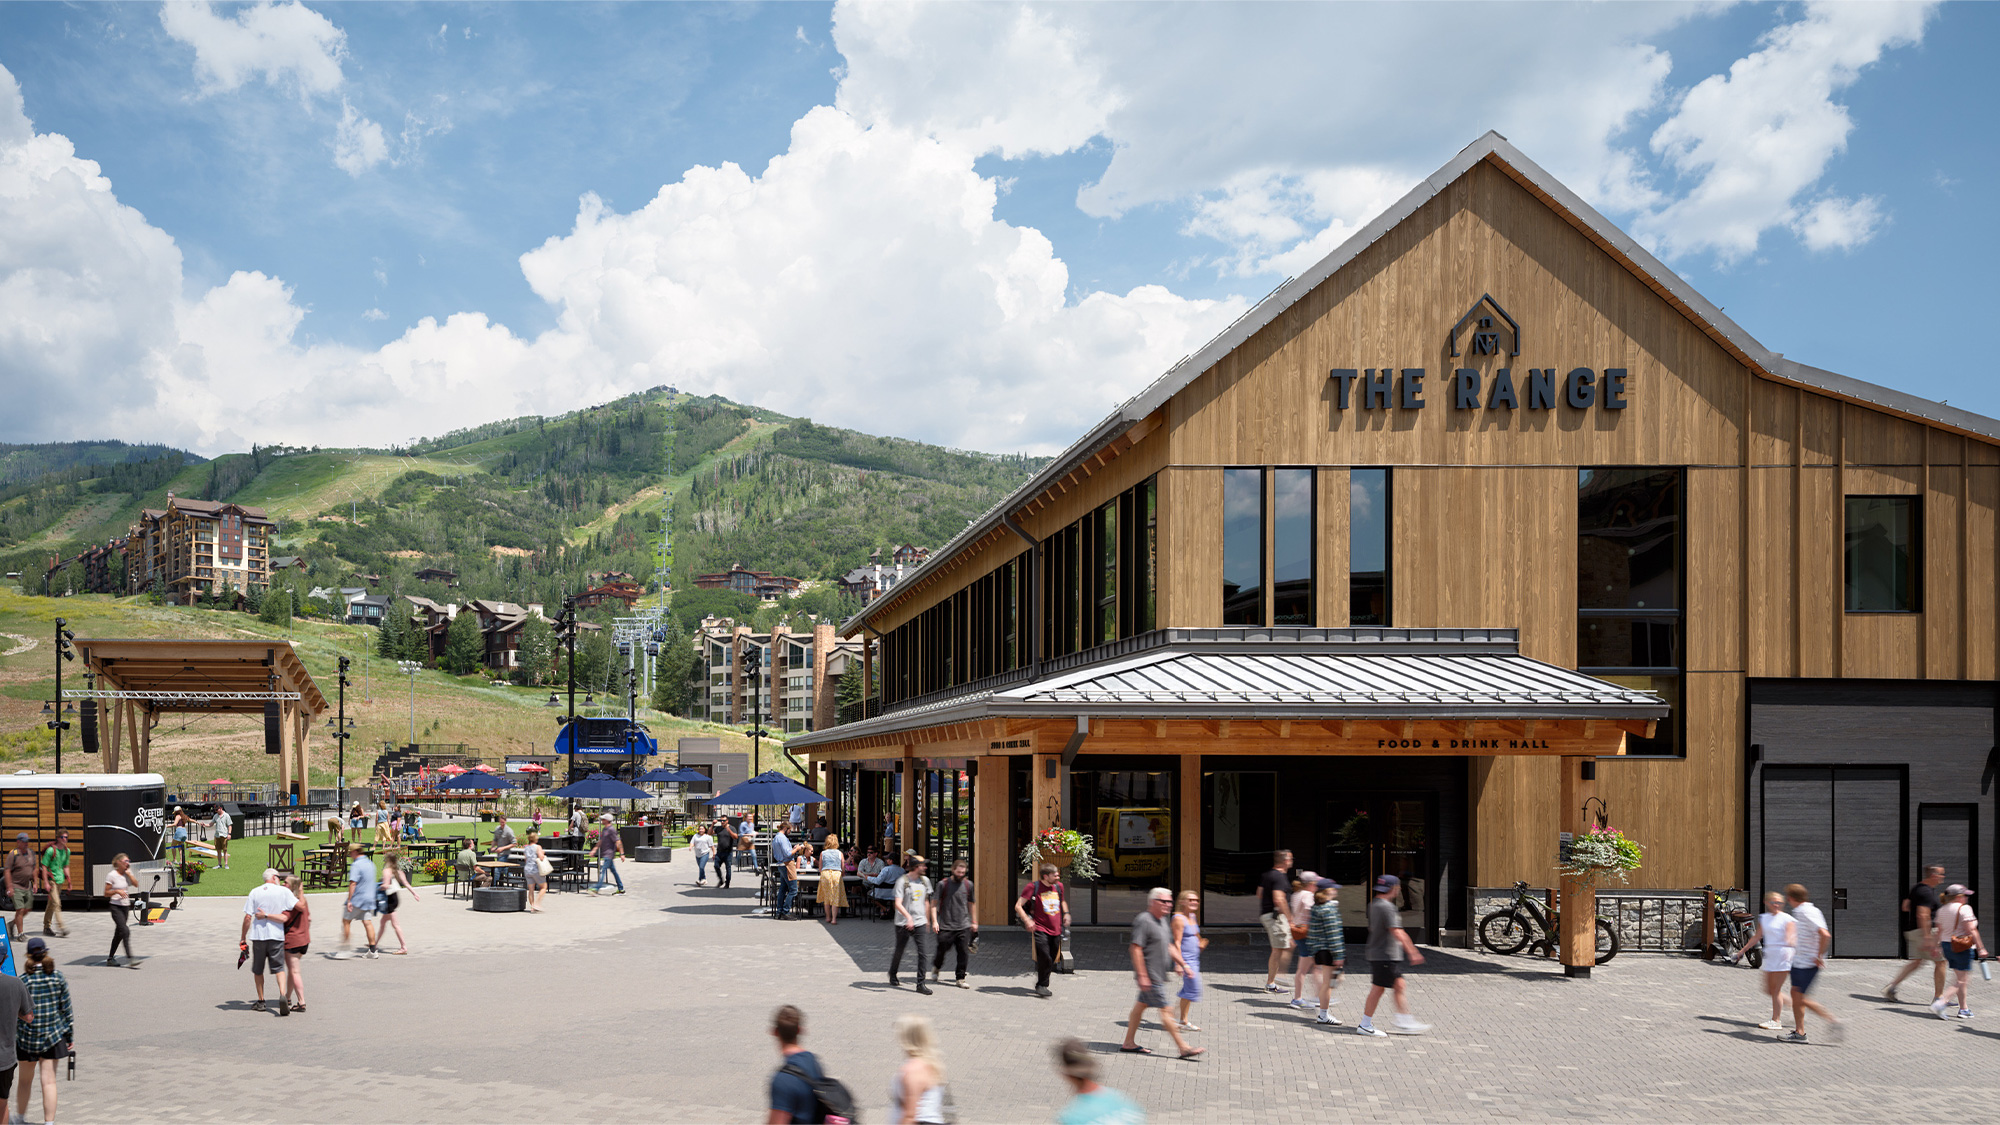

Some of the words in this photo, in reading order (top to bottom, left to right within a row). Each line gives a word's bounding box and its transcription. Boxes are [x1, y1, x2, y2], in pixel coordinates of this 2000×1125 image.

[1330, 368, 1426, 410] THE
[1455, 366, 1628, 410] RANGE
[1378, 739, 1422, 749] FOOD
[1431, 739, 1440, 749] &
[1450, 739, 1499, 749] DRINK
[1509, 740, 1550, 749] HALL
